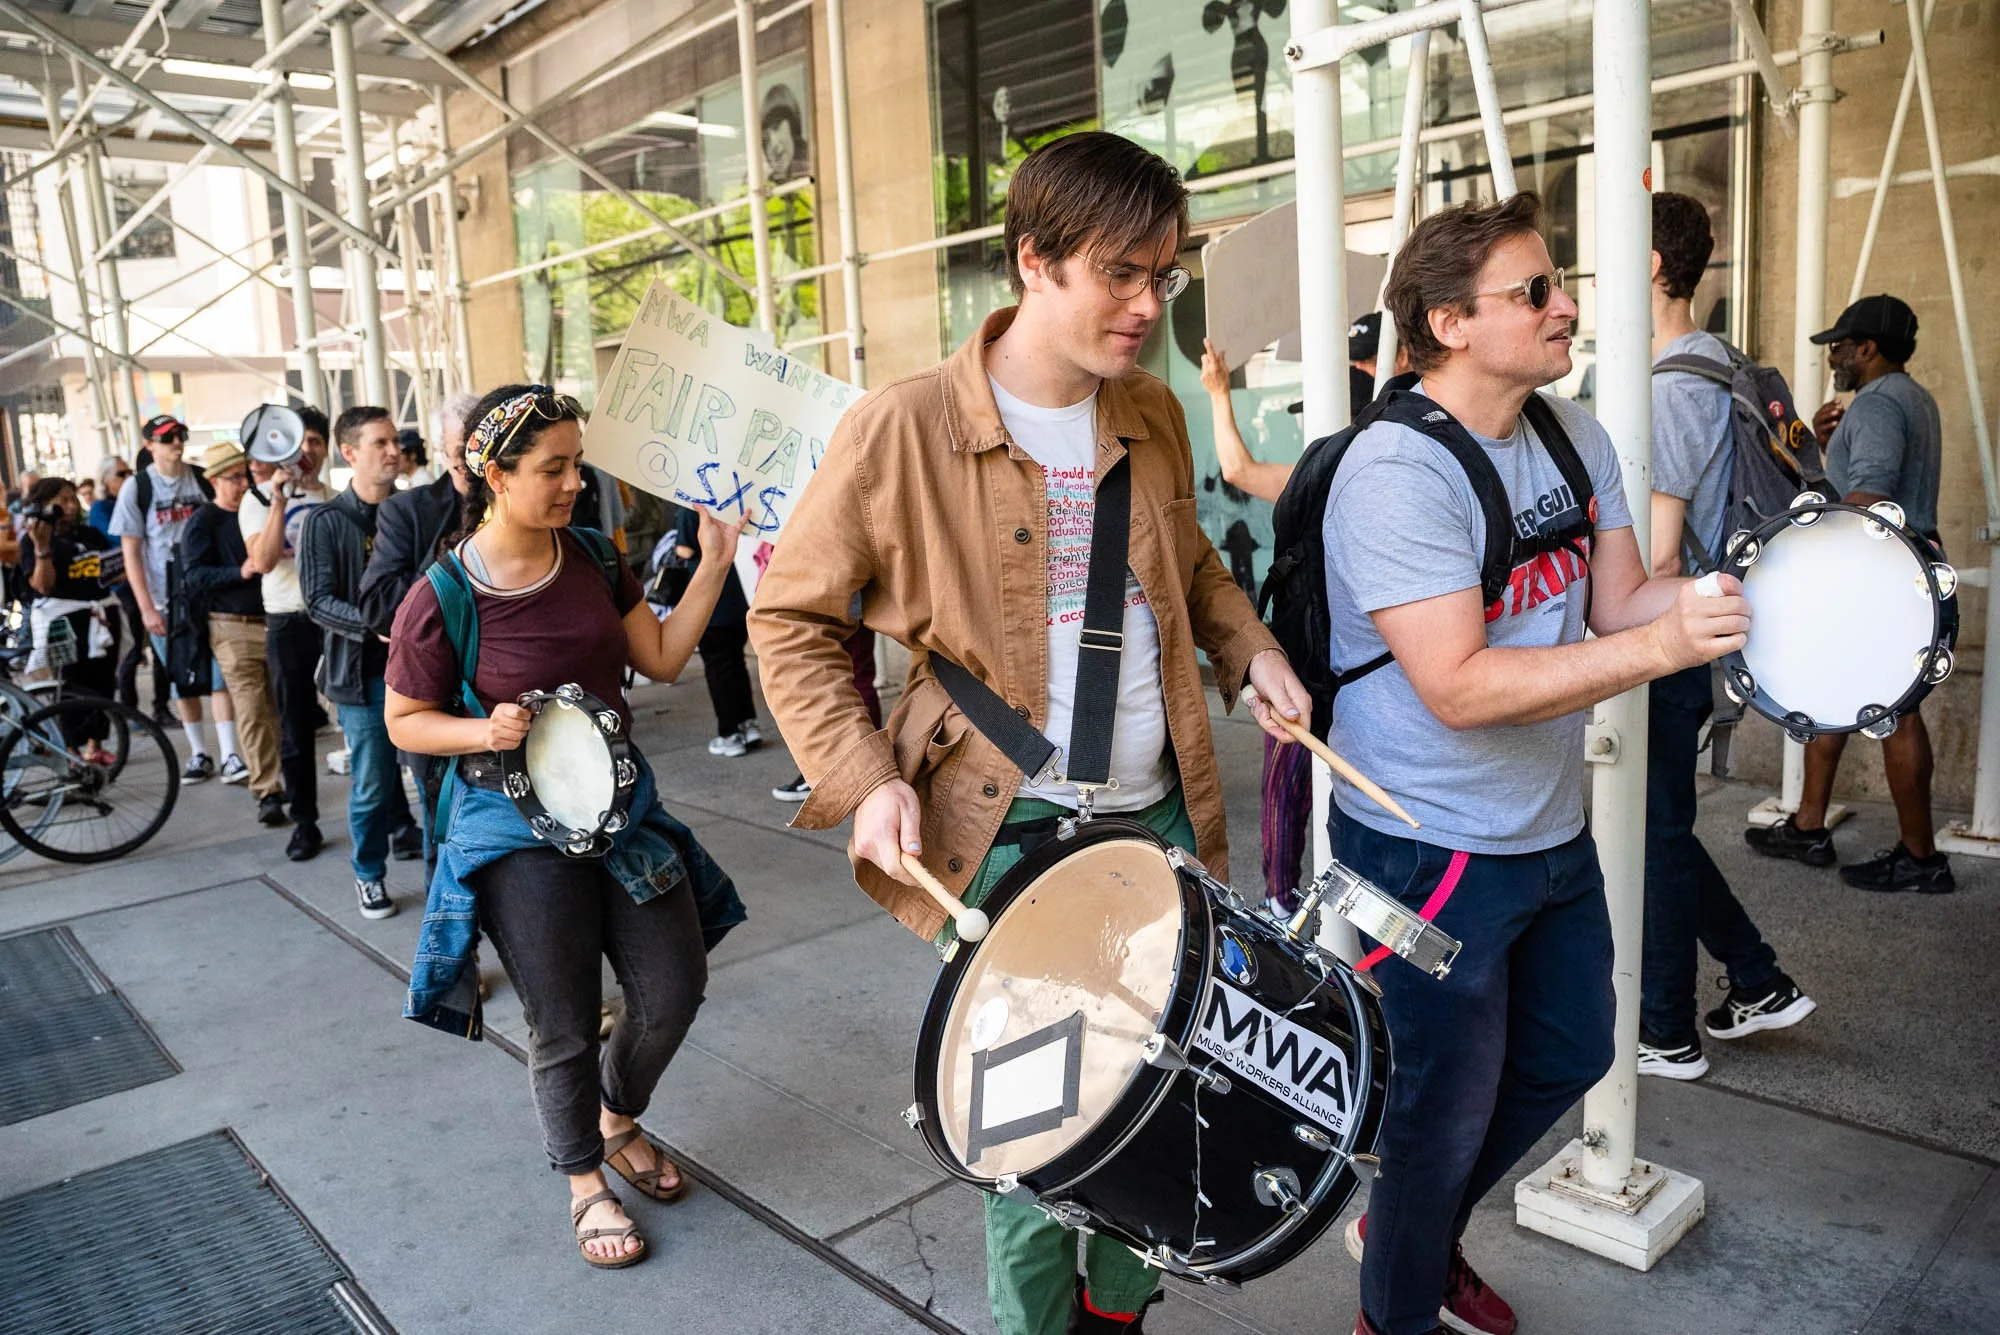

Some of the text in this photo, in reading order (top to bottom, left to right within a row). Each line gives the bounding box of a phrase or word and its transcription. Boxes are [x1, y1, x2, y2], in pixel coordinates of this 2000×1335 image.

[641, 288, 850, 409] MWA WANTS
[606, 348, 736, 454] FAIR
[1063, 495, 1073, 508] &
[1537, 484, 1580, 518] GUI
[1050, 570, 1088, 581] conse
[1054, 550, 1081, 562] right
[1197, 1033, 1344, 1129] MUSIC WORKERS ALLIANCE
[1203, 983, 1347, 1115] MWA
